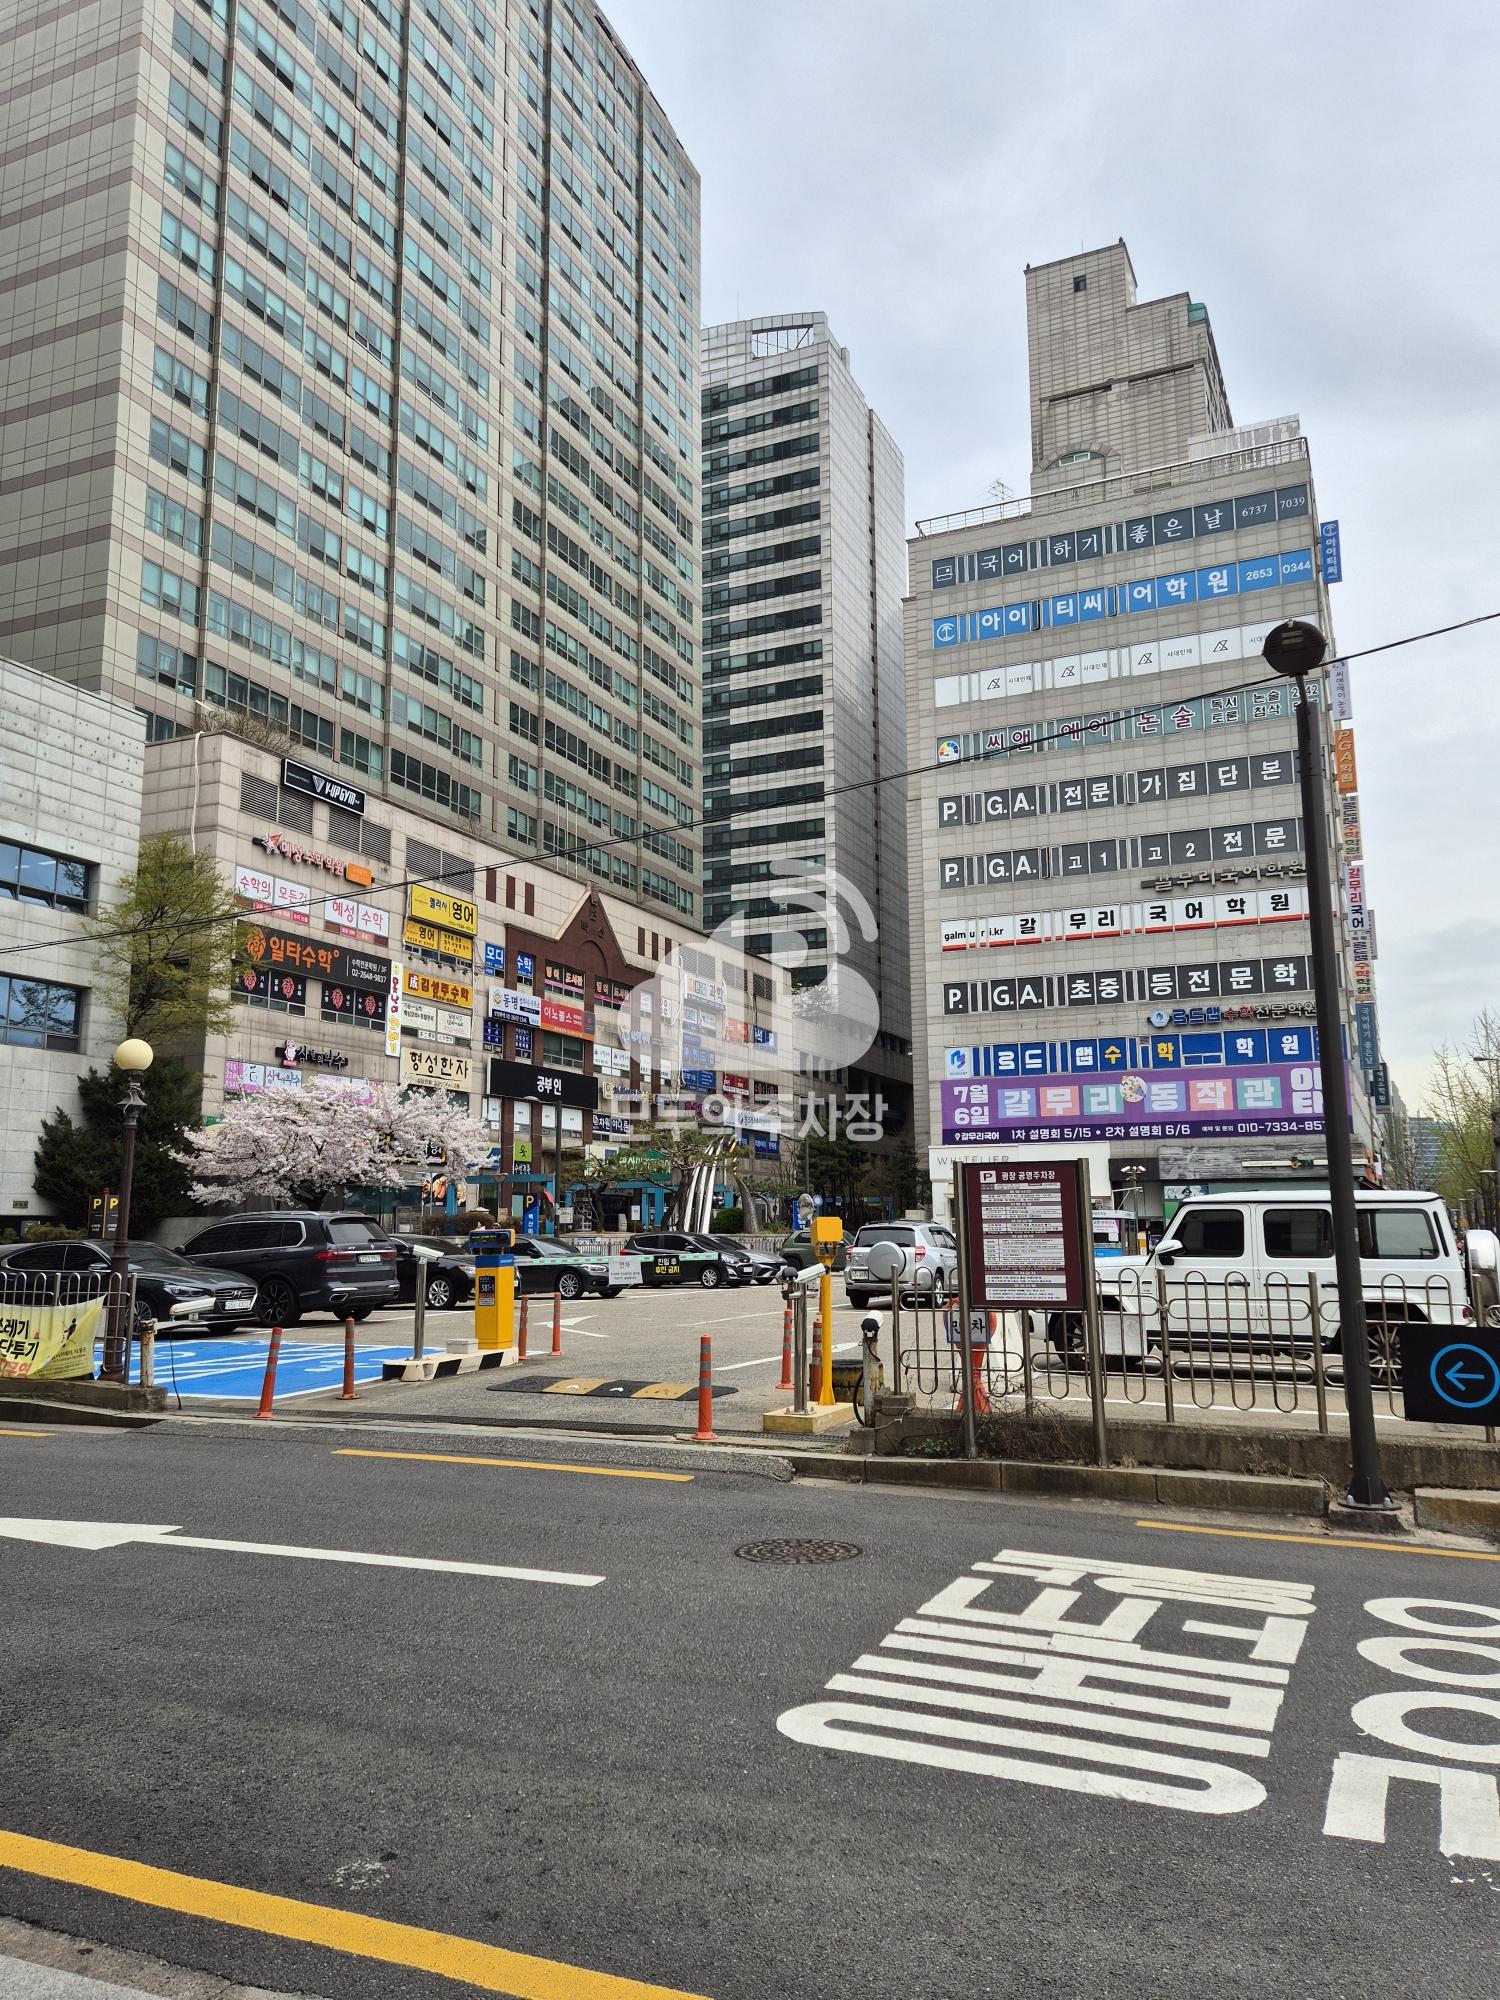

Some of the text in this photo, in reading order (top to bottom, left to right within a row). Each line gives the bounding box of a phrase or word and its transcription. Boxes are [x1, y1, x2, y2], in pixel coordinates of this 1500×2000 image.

[1241, 504, 1268, 518] 6737
[1279, 496, 1306, 509] 7039
[1246, 568, 1273, 581] 2653
[1282, 561, 1312, 575] 0344
[1252, 690, 1280, 704] 논술
[1291, 684, 1319, 698] 242
[1211, 697, 1238, 710] 독서
[1254, 704, 1281, 718] 첨삭
[1212, 711, 1238, 724] 토론
[239, 875, 271, 898] 수학의
[332, 899, 383, 930] 혜성 수학
[452, 901, 475, 925] 영어
[419, 926, 435, 942] 영어
[536, 1075, 562, 1096] 공부인
[953, 1084, 989, 1104] 7월
[954, 1106, 990, 1126] 6일
[1011, 1130, 1026, 1141] 1차
[1029, 1128, 1061, 1140] 설명회
[1063, 1127, 1092, 1139] 5/15
[1105, 1126, 1125, 1137] 2차
[1128, 1124, 1162, 1137] 설명회
[1165, 1124, 1191, 1135] 6/6
[984, 1172, 993, 1181] P
[93, 1199, 102, 1209] P
[110, 1198, 119, 1209] P
[526, 1195, 535, 1208] P
[0, 1317, 29, 1339] 레기
